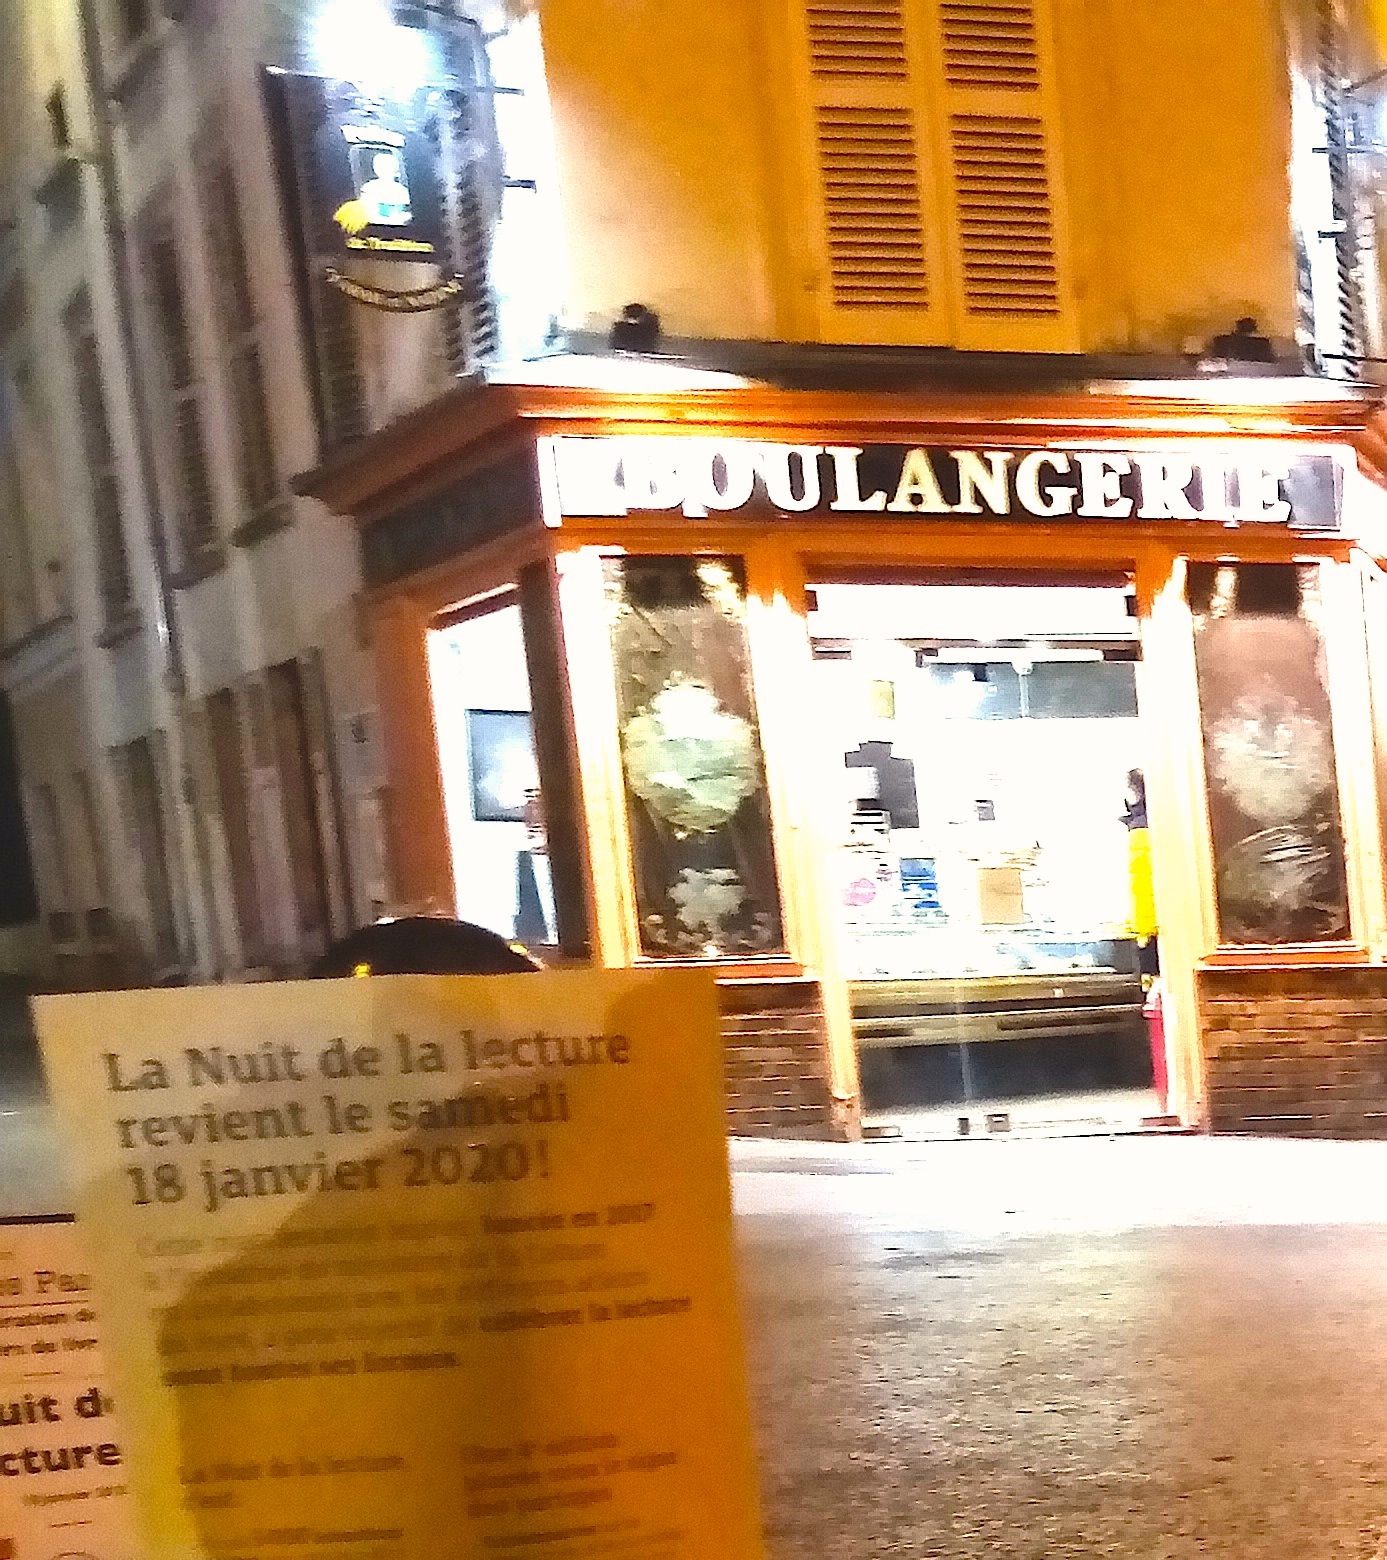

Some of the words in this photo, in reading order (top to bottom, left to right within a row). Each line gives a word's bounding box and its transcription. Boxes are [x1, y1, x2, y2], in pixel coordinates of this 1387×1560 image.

[632, 443, 1293, 524] BOULANGERIE
[100, 1051, 170, 1092] La
[183, 1043, 305, 1087] Nuit
[318, 1037, 382, 1079] de
[394, 1031, 447, 1075] la
[459, 1028, 631, 1072] lecture
[116, 1102, 313, 1149] revient
[322, 1095, 373, 1135] le
[386, 1082, 570, 1132] samedi
[127, 1162, 185, 1206] 18
[201, 1150, 383, 1213] janvier
